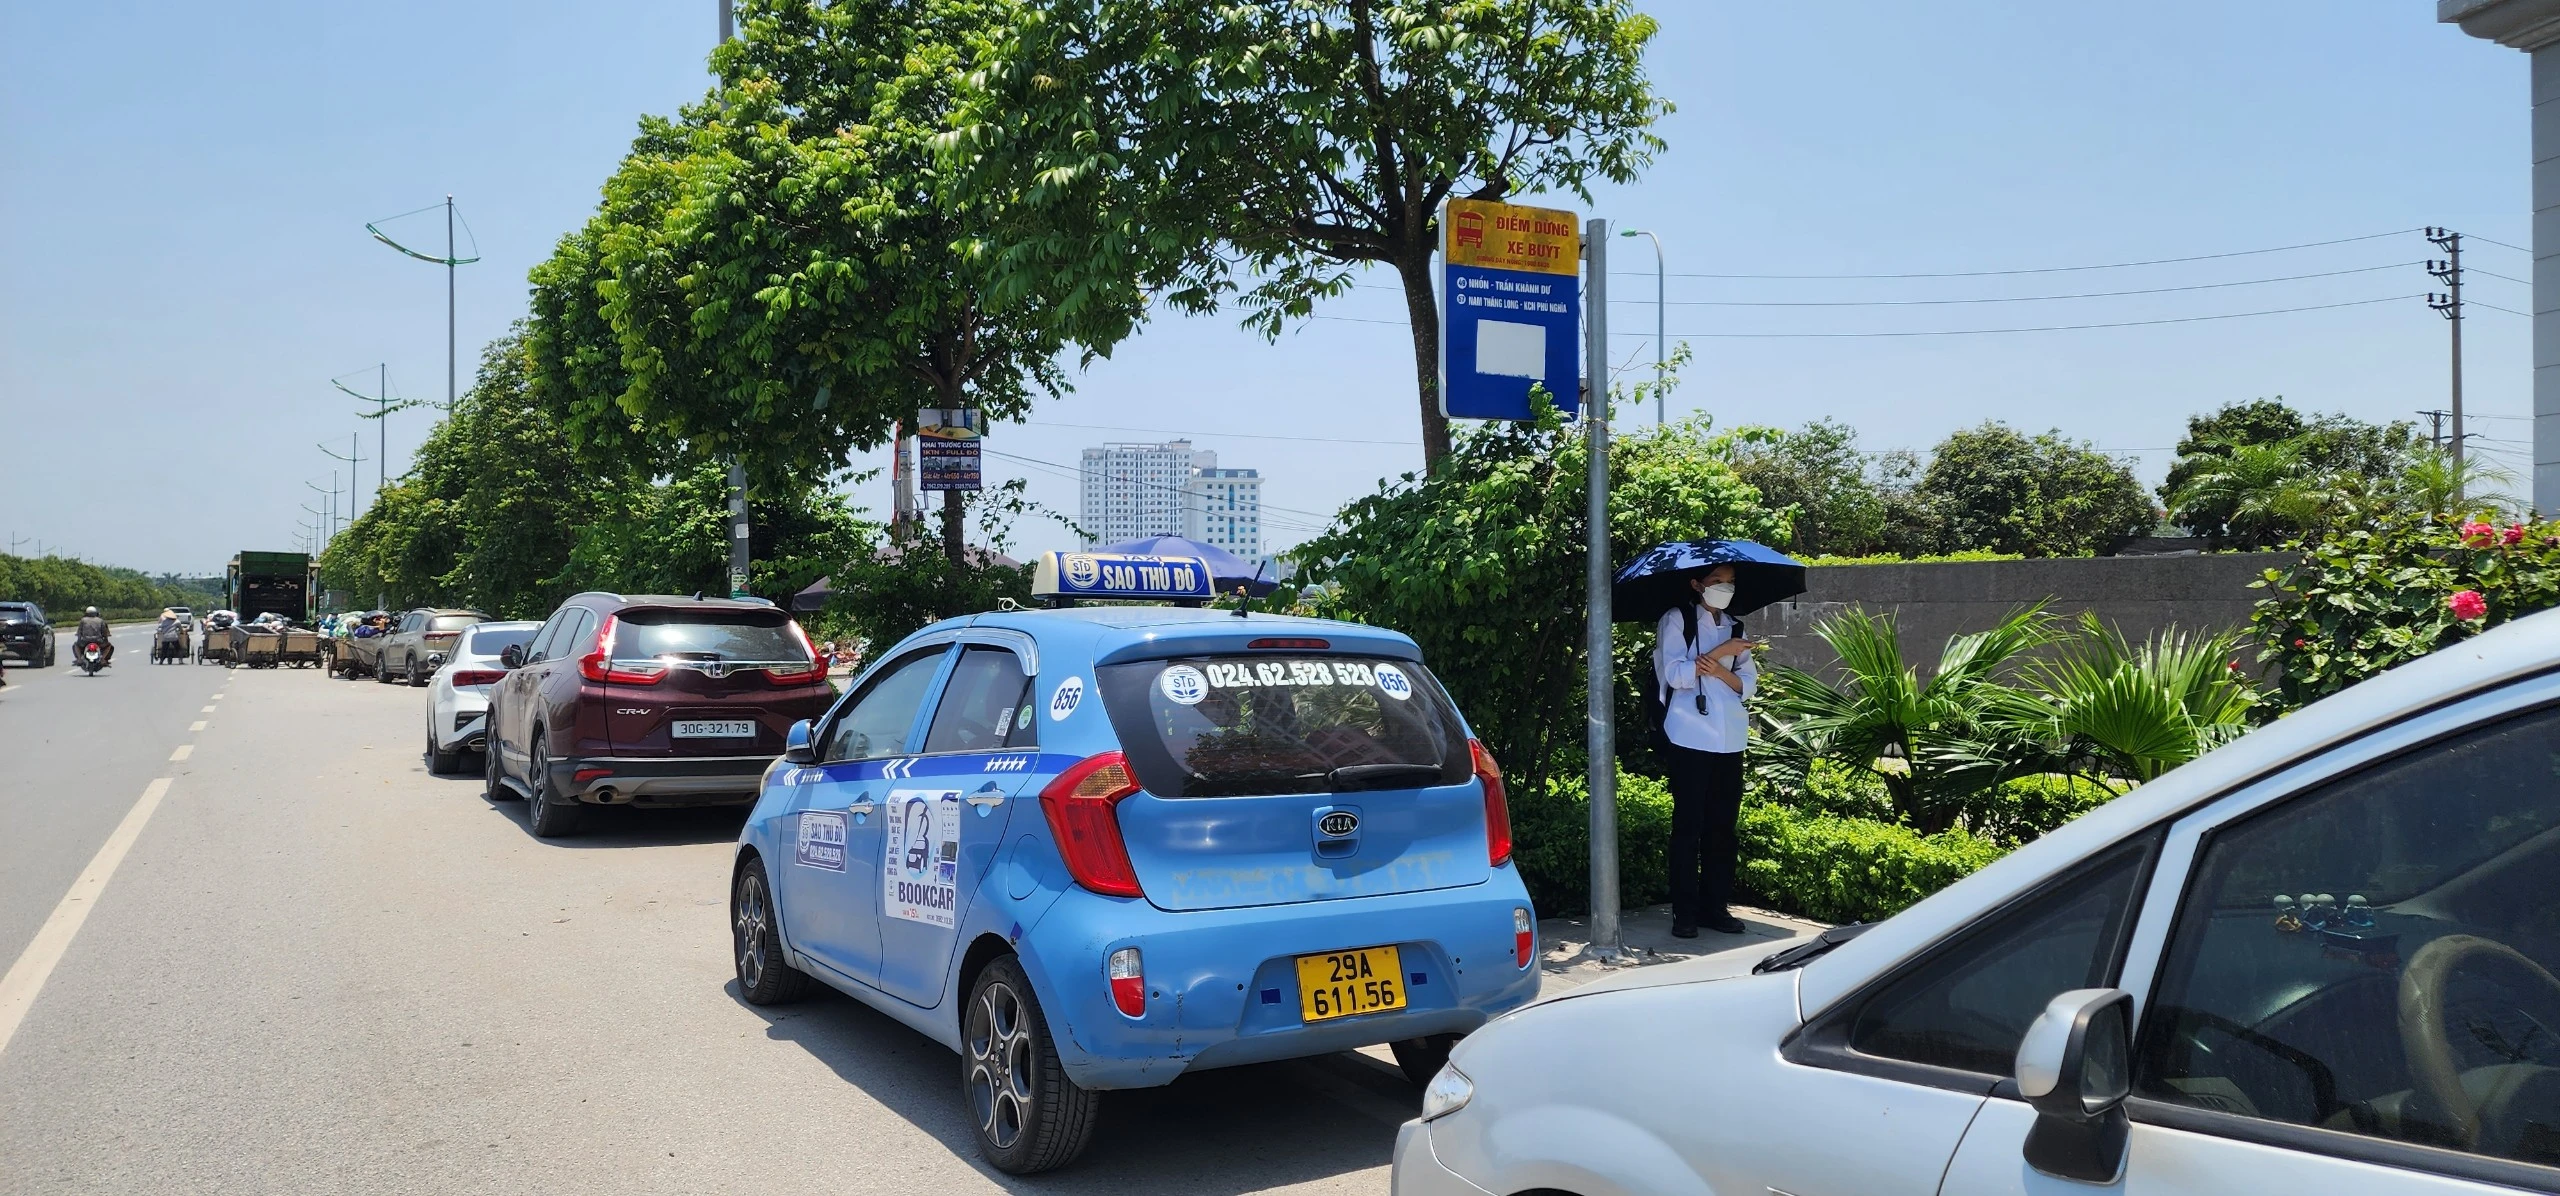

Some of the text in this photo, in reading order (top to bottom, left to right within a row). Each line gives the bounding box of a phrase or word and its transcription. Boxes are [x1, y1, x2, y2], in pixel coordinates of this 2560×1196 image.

[1496, 213, 1569, 237] ĐIỂM DỪNG
[1507, 240, 1560, 259] XE BUÝT
[1515, 281, 1540, 294] KHÁNH
[1541, 284, 1552, 295] DƯ
[1468, 295, 1483, 307] NAM
[1503, 299, 1519, 310] LONG
[1523, 300, 1536, 311] KCN
[1536, 300, 1549, 312] PHÚ
[1103, 562, 1196, 592] SAO THỦ ĐÔ
[1206, 662, 1376, 688] 024.62.528 528
[1378, 671, 1409, 693] 856
[1053, 688, 1081, 711] 856
[811, 822, 821, 841] SAO
[1326, 817, 1354, 831] KIA
[898, 881, 954, 911] BOOKCAR
[1327, 952, 1373, 983] 29A
[1313, 980, 1395, 1016] 611.56
